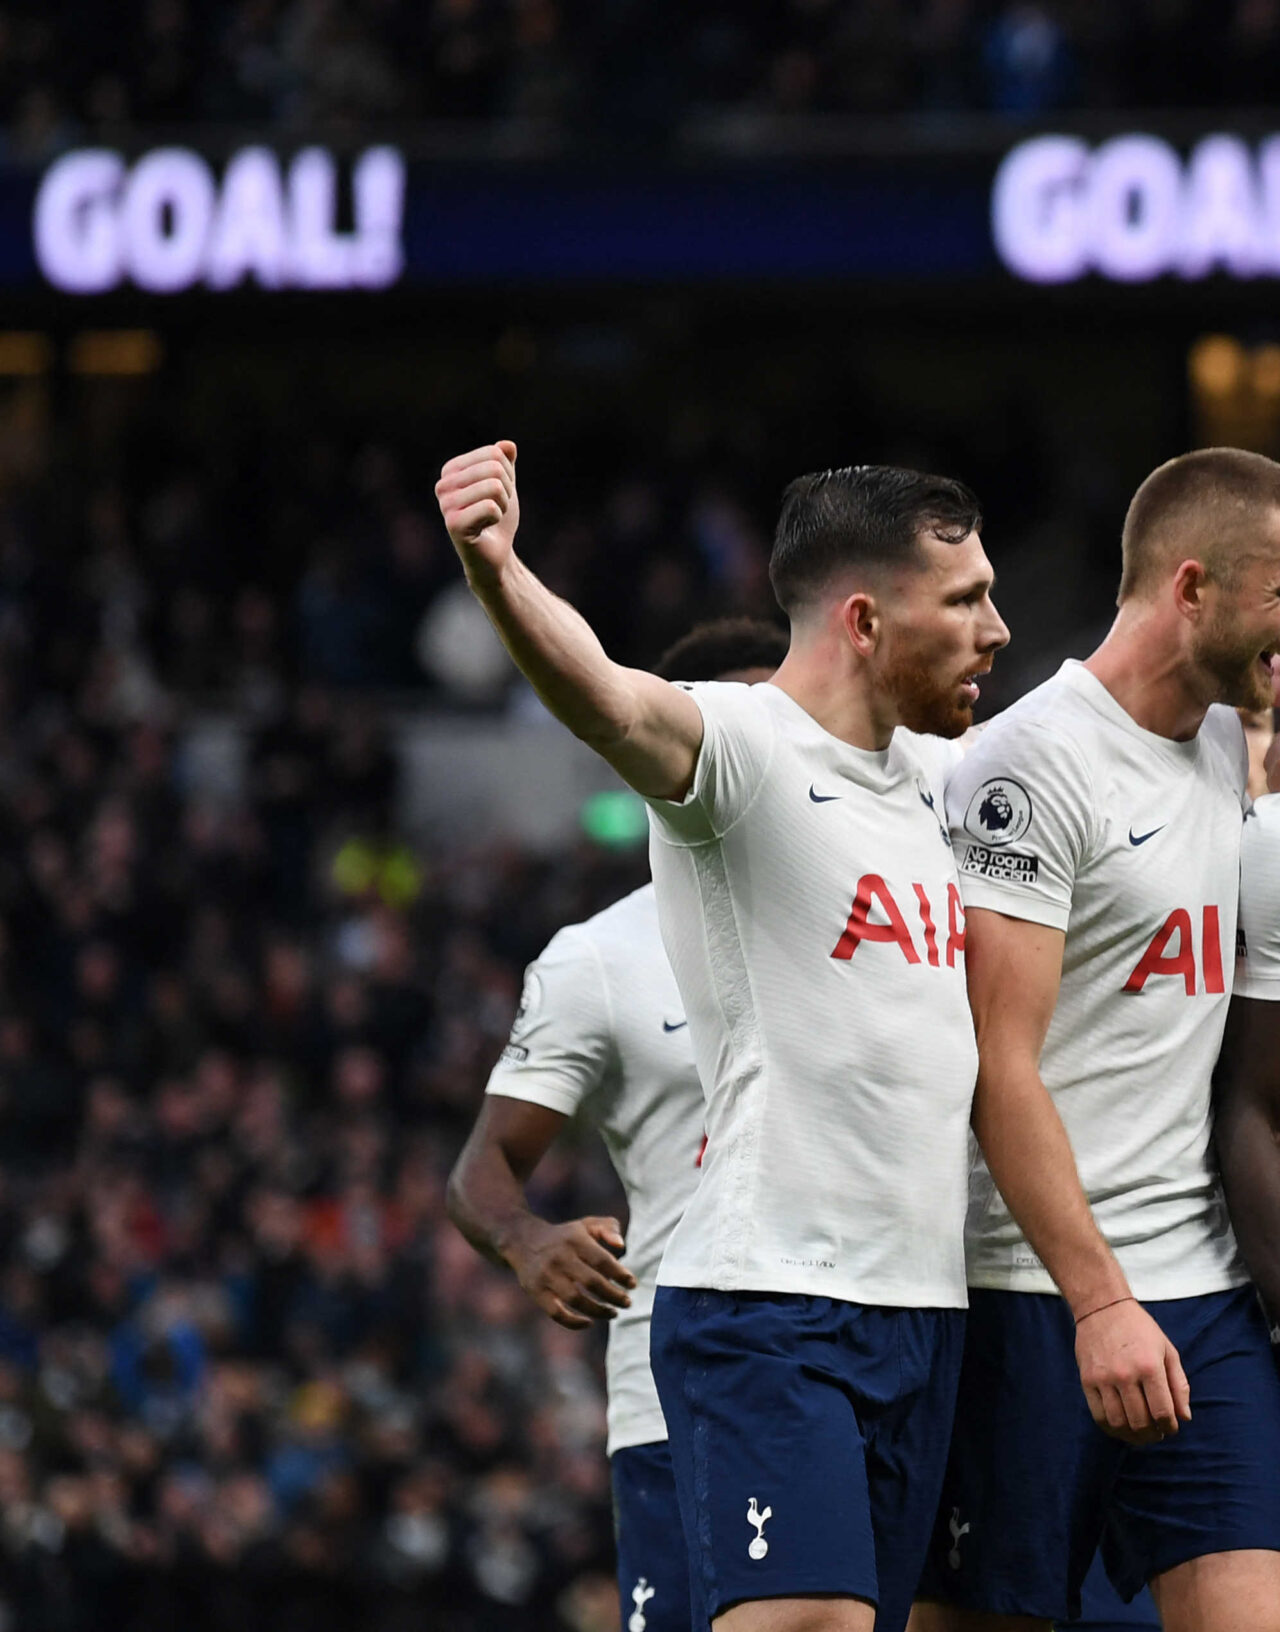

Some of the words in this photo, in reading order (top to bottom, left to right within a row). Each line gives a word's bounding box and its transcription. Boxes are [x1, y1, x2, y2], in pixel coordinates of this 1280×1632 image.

[35, 147, 403, 293] GOAL!
[966, 846, 988, 862] No
[990, 853, 1031, 870] room
[986, 865, 1036, 883] racism
